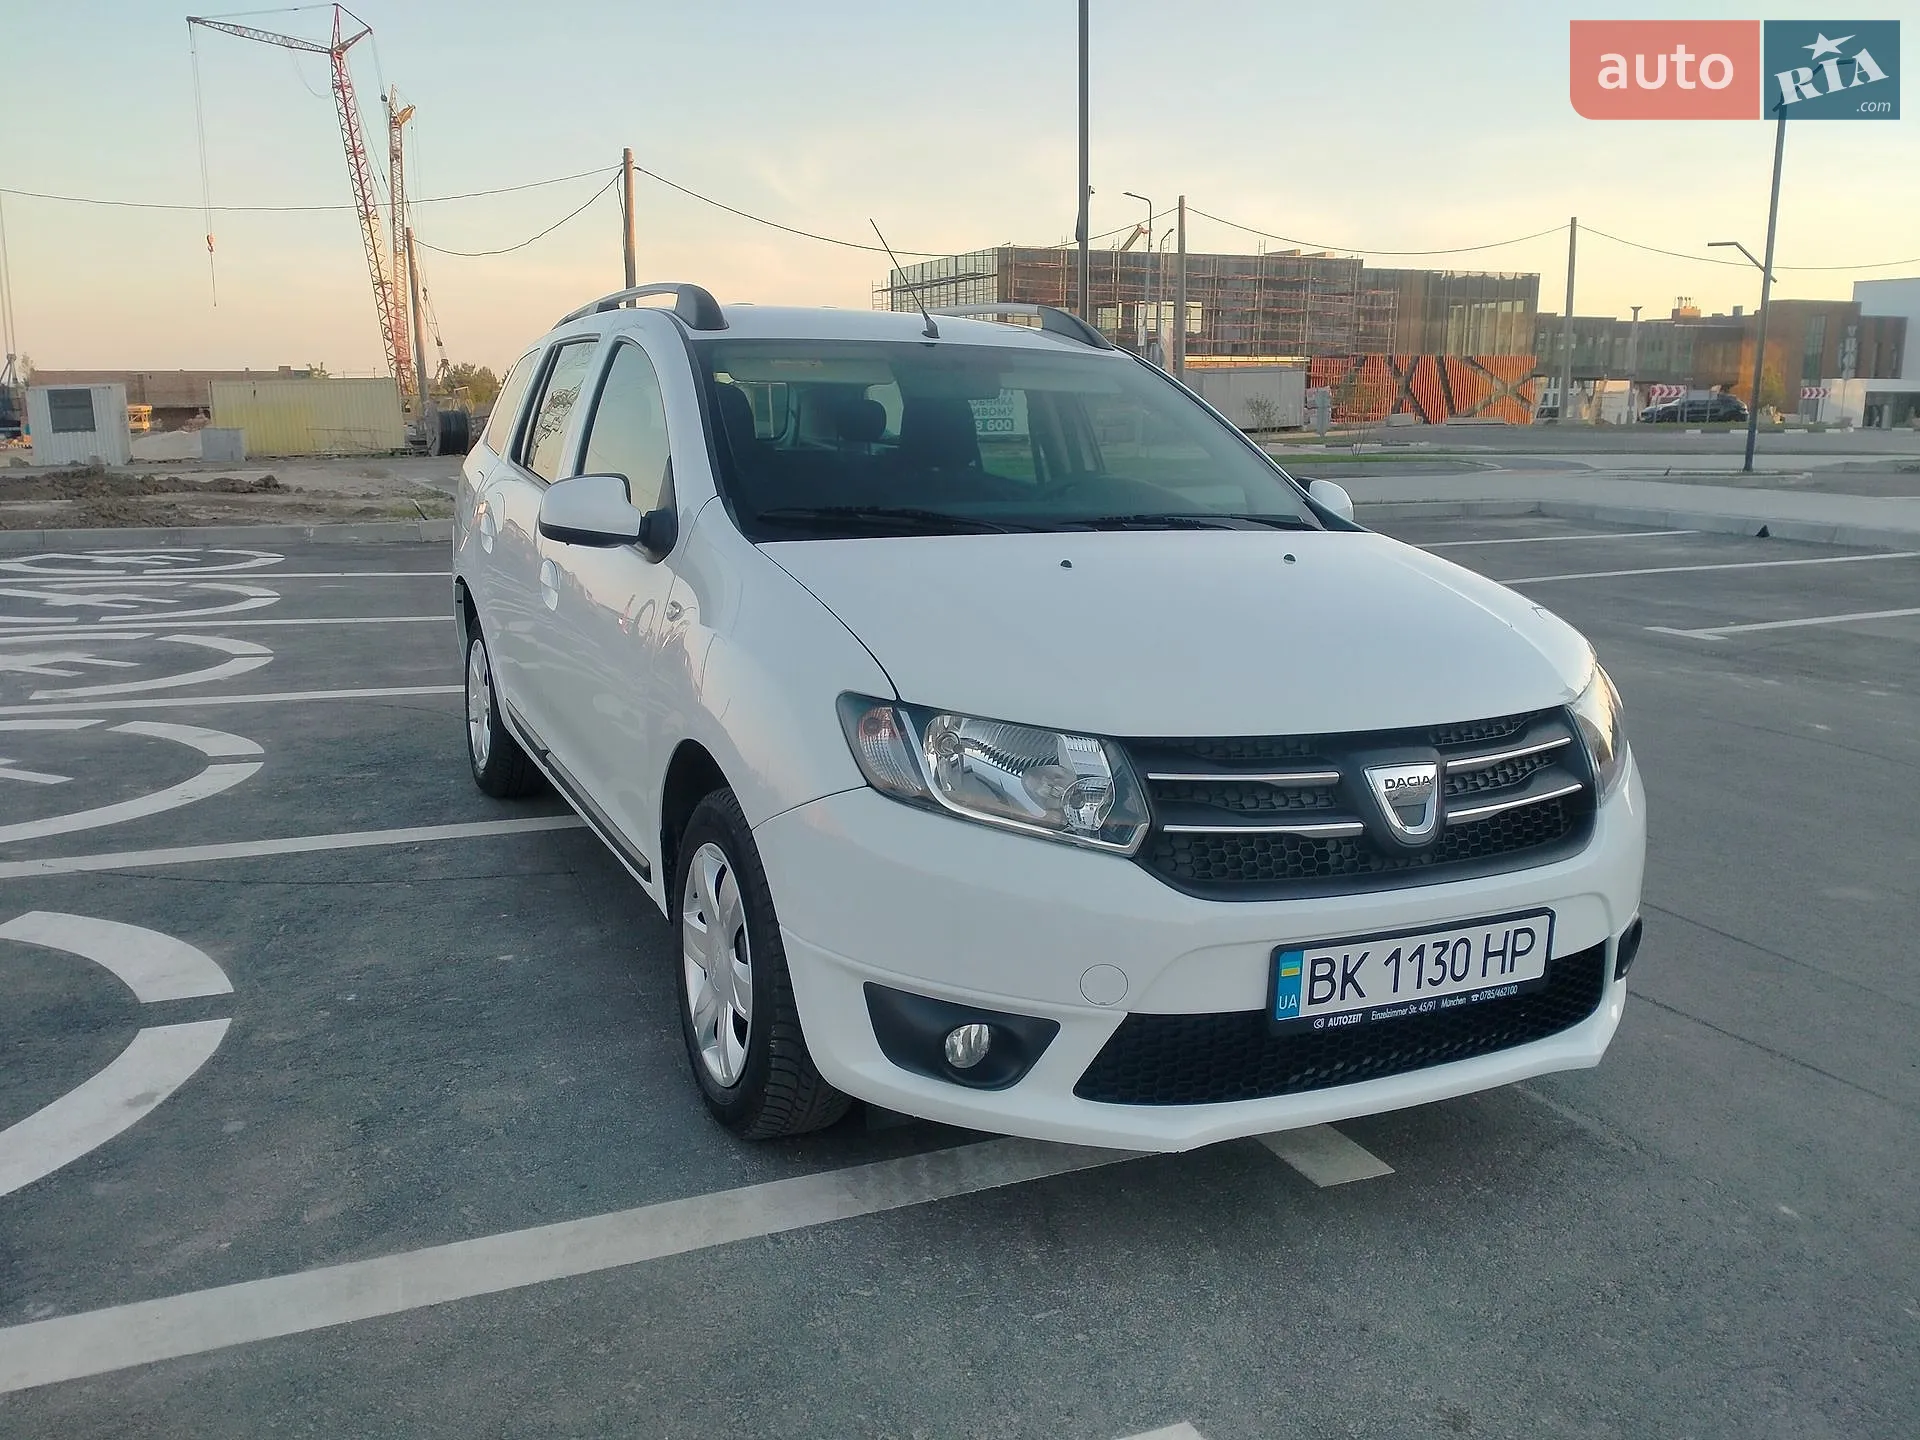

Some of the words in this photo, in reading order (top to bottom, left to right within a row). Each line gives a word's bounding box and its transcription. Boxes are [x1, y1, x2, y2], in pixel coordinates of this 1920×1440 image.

[987, 419, 1012, 431] 600
[1384, 775, 1432, 789] DACIA
[1308, 951, 1370, 1006] BK
[1384, 937, 1471, 993] 1130
[1481, 927, 1536, 977] HP
[1278, 993, 1298, 1010] UA
[1327, 1013, 1362, 1028] AUTOZEIT
[1419, 1000, 1437, 1013] 45/91
